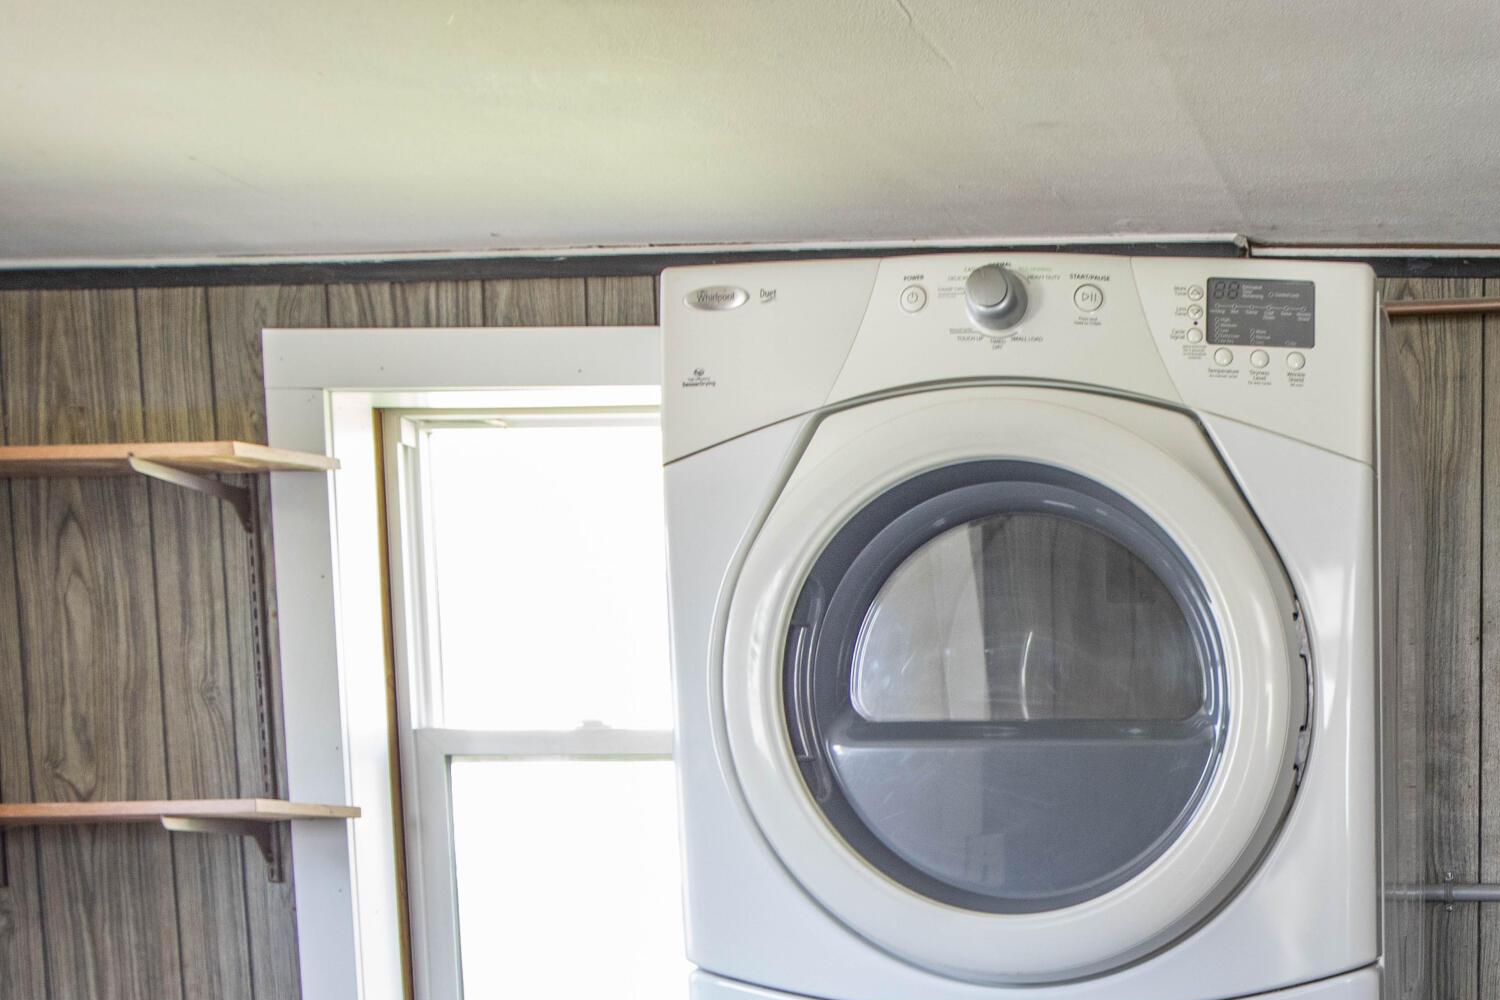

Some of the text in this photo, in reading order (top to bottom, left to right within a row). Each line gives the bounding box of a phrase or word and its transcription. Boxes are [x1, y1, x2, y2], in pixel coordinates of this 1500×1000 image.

[1070, 273, 1110, 281] START/PAUSE
[697, 289, 735, 304] Whirlpool
[760, 288, 777, 300] Duet
